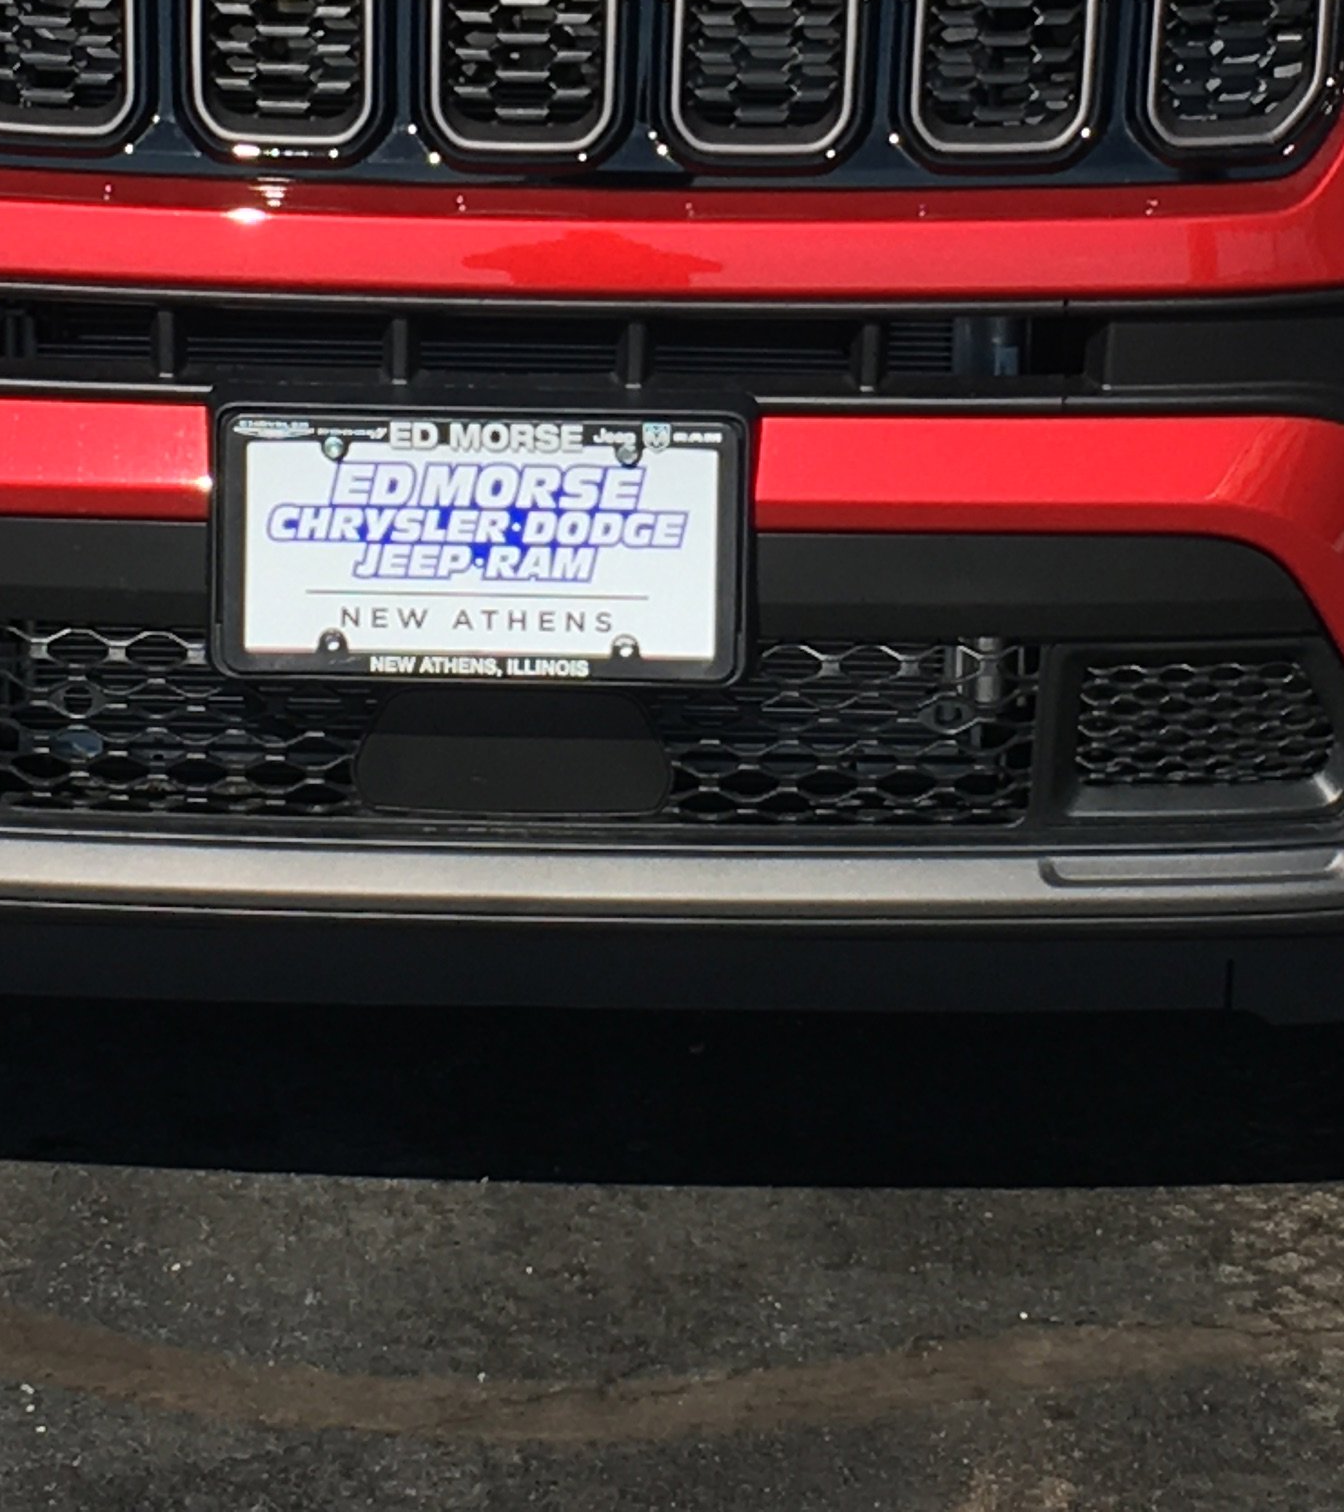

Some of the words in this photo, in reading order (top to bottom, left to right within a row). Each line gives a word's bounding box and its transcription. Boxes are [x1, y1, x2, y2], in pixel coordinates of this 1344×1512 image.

[390, 422, 438, 450] ED
[450, 423, 584, 452] MORSE
[331, 462, 416, 507] ED
[420, 464, 646, 510] MORSE
[267, 504, 511, 544] CHRYSLER
[520, 510, 689, 548] DODGE
[353, 543, 473, 579] JEEP
[481, 546, 598, 582] RAM
[341, 606, 428, 629] NEW
[452, 609, 613, 633] ATHENS
[369, 656, 416, 673] NEW
[419, 657, 503, 678] ATHENS,
[506, 659, 590, 677] ILLINOIS
